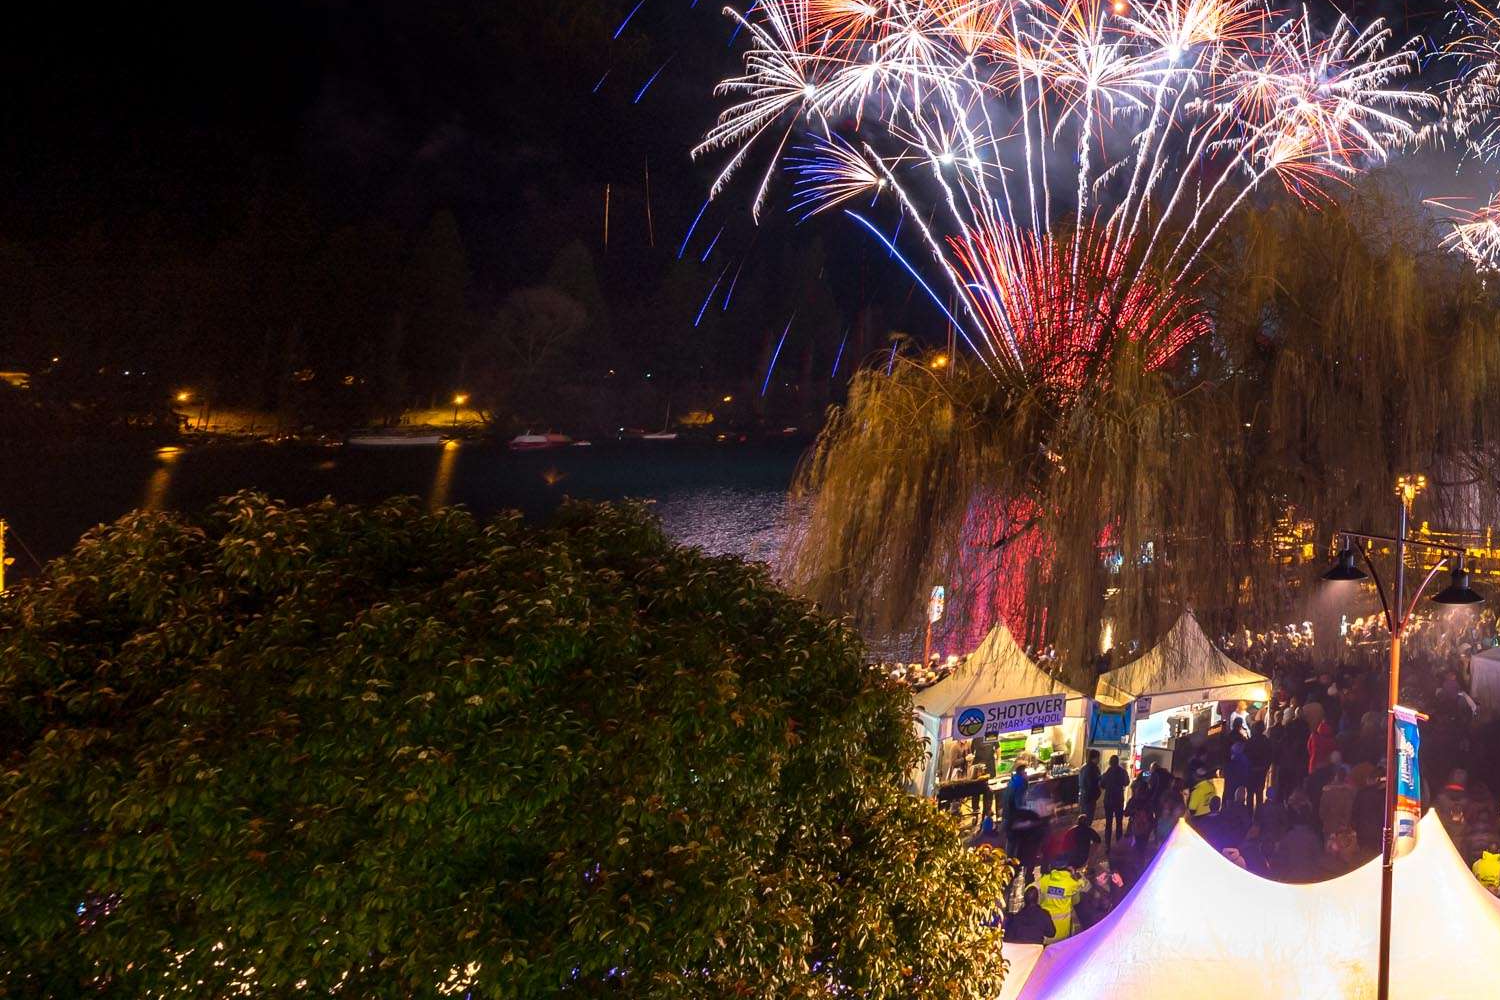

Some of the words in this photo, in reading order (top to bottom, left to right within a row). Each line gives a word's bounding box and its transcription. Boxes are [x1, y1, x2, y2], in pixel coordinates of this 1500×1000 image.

[986, 698, 1063, 722] SHOTOVER
[986, 718, 1026, 733] PRIMARY
[1027, 713, 1060, 726] SCHOOL
